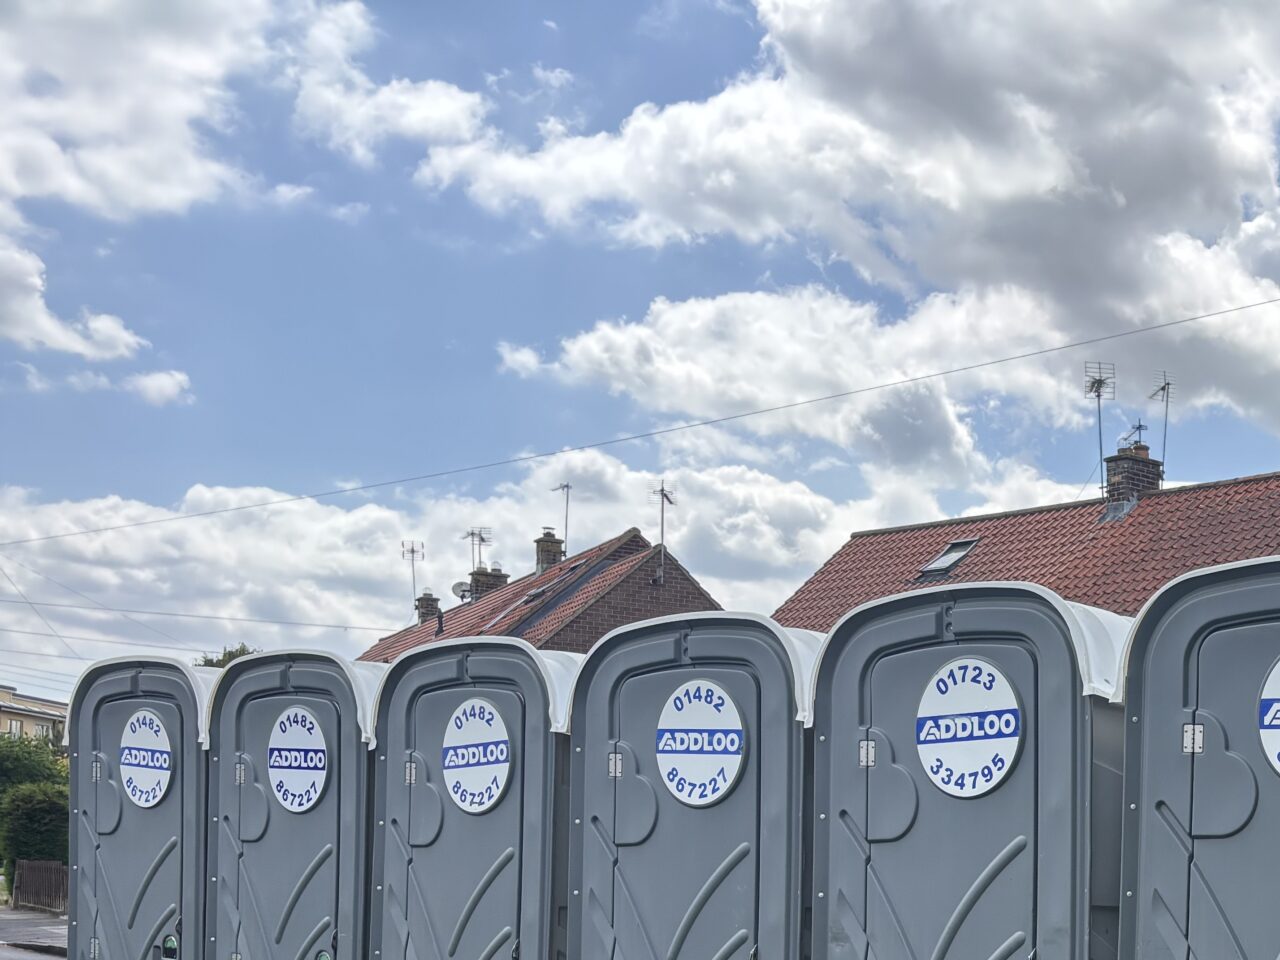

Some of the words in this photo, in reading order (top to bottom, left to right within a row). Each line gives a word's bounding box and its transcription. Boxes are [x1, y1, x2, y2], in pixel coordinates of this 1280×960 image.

[935, 664, 996, 695] 01723
[673, 686, 725, 713] 01482
[130, 715, 161, 738] 01482
[279, 712, 315, 736] 01482
[454, 704, 495, 730] 01482
[919, 713, 1016, 741] ADDLOO
[444, 743, 507, 767] ADDLOO
[658, 732, 740, 752] ADDLOO
[121, 748, 170, 769] ADDLOO
[269, 750, 325, 769] ADDLOO
[930, 752, 1006, 791] 334795
[126, 777, 163, 803] 867227
[275, 780, 318, 807] 867227
[452, 775, 501, 807] 867227
[667, 767, 728, 799] 867227
